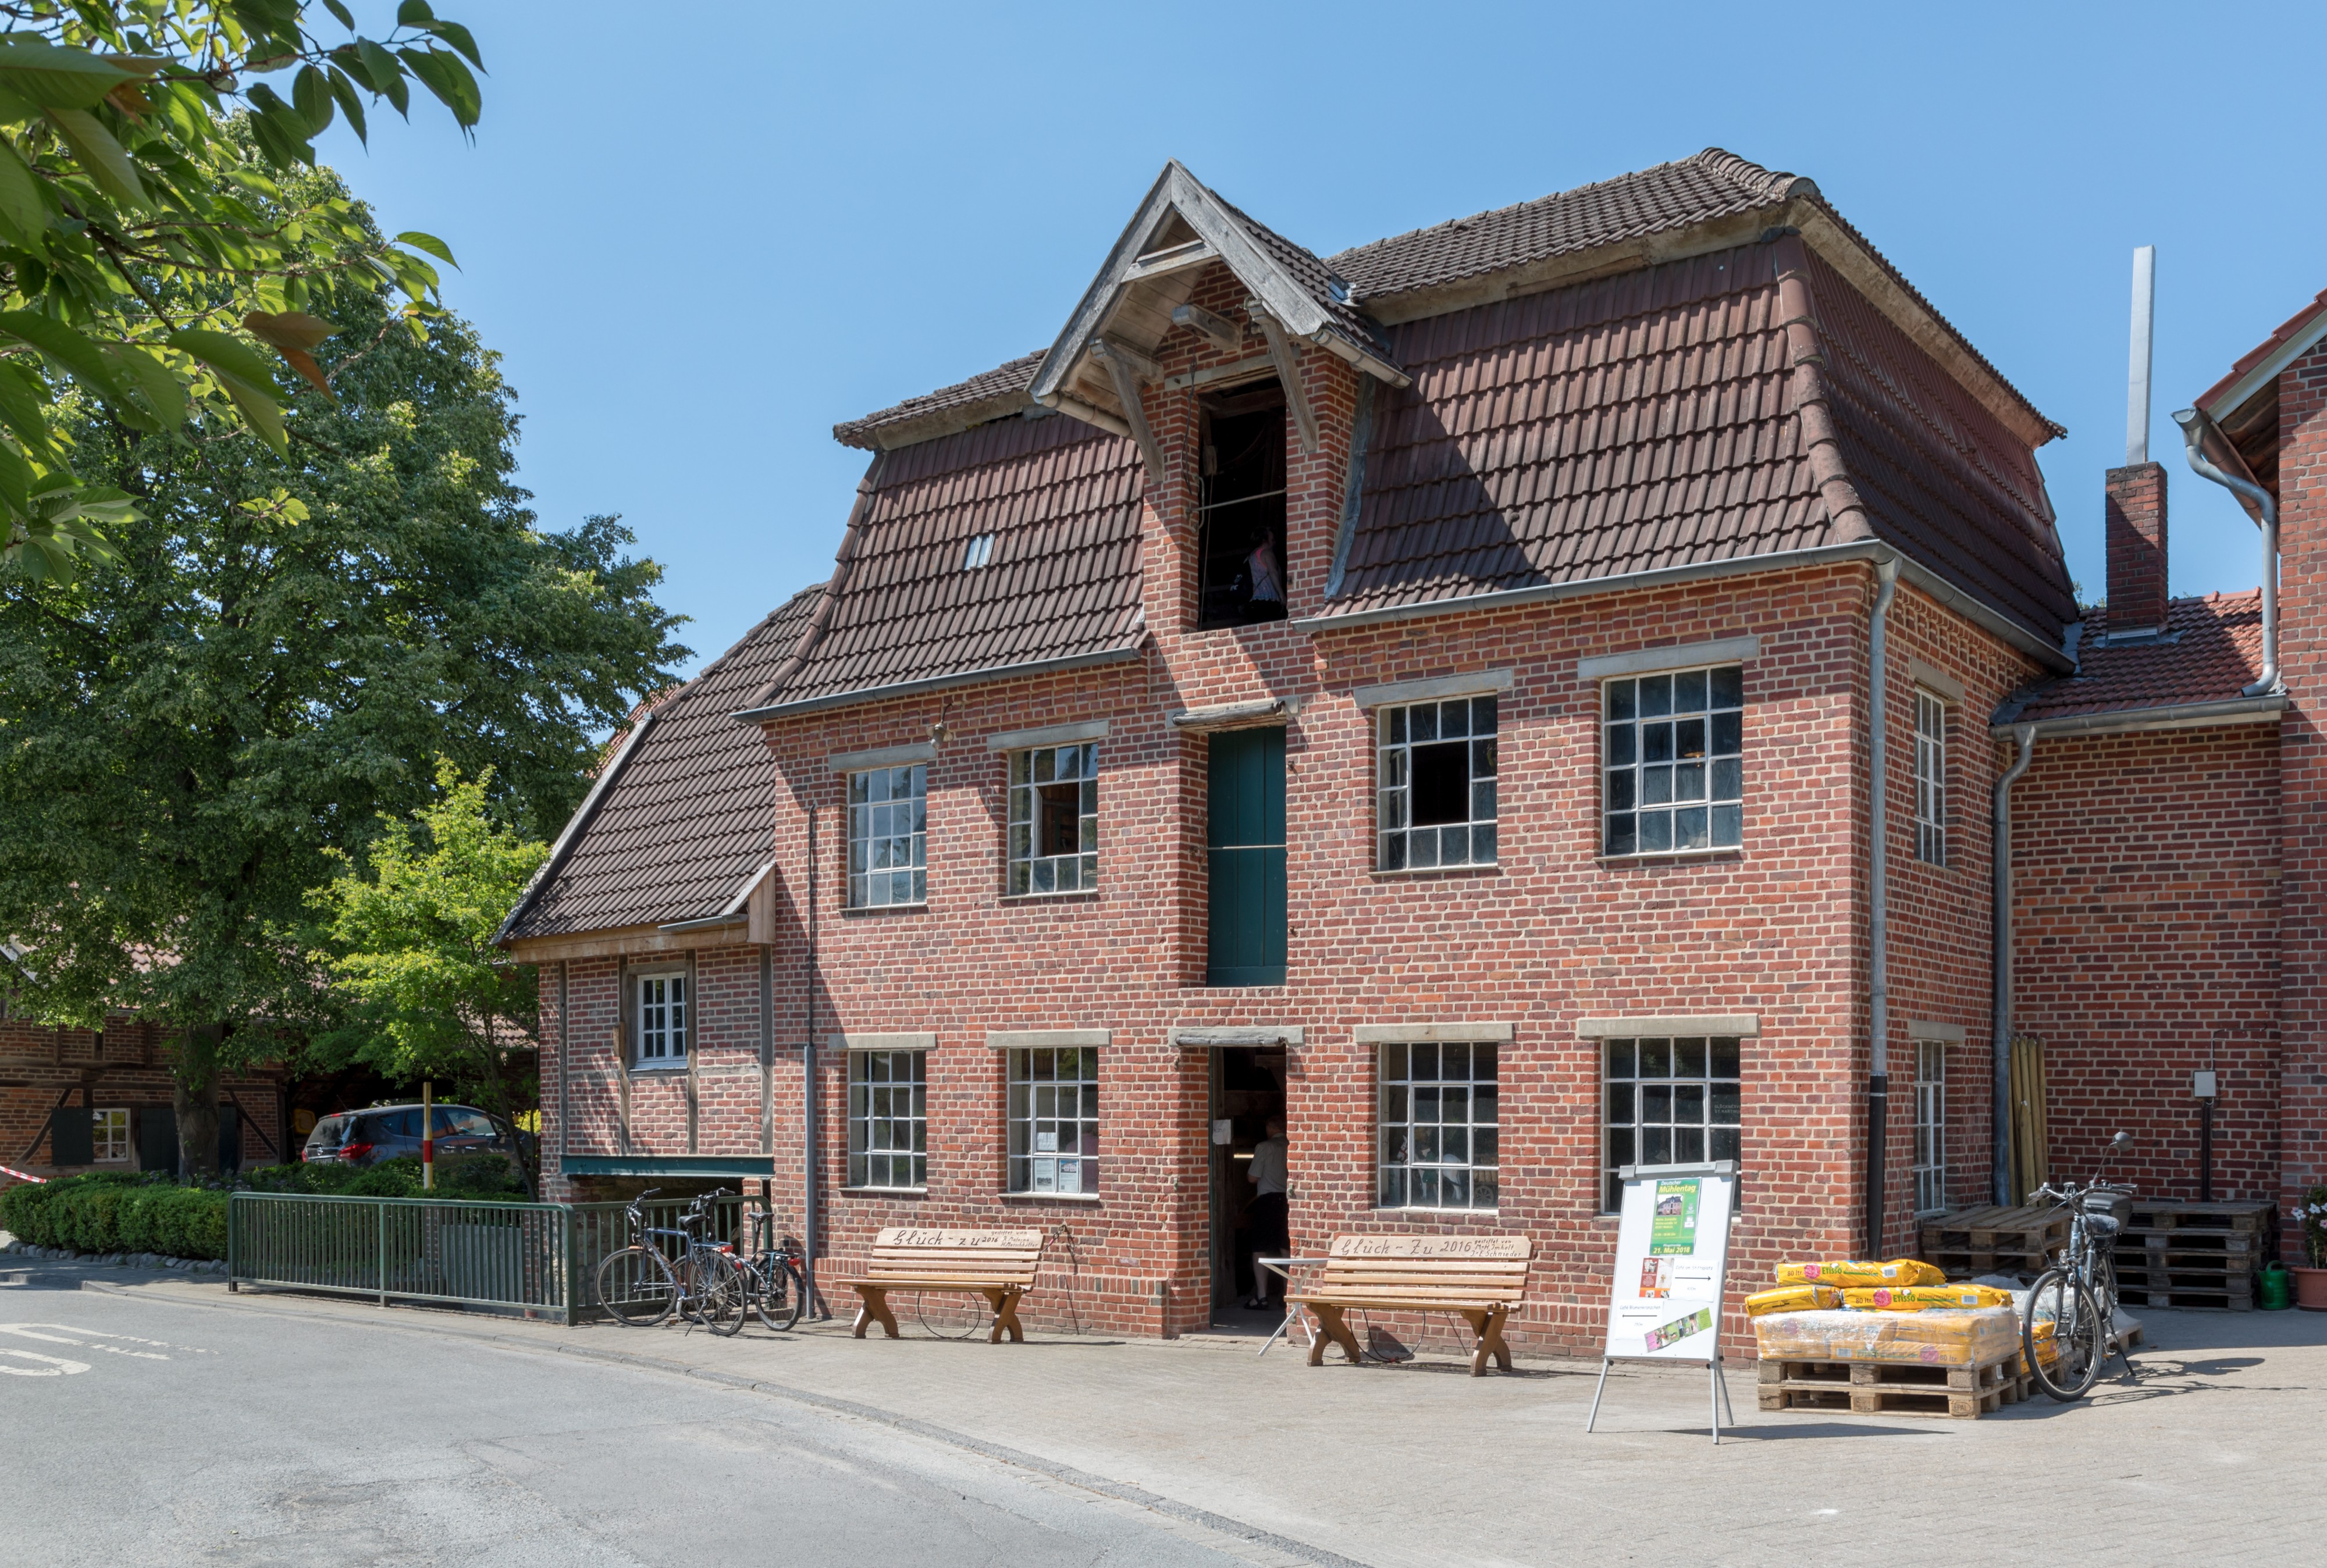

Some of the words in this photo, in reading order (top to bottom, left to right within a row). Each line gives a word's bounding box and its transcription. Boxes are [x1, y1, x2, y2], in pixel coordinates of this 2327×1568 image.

[1659, 1185, 1696, 1193] Mühlentag
[893, 1230, 943, 1245] Glück
[1341, 1238, 1390, 1255] Glück
[1410, 1239, 1433, 1255] Zu
[1439, 1241, 1472, 1252] 2016
